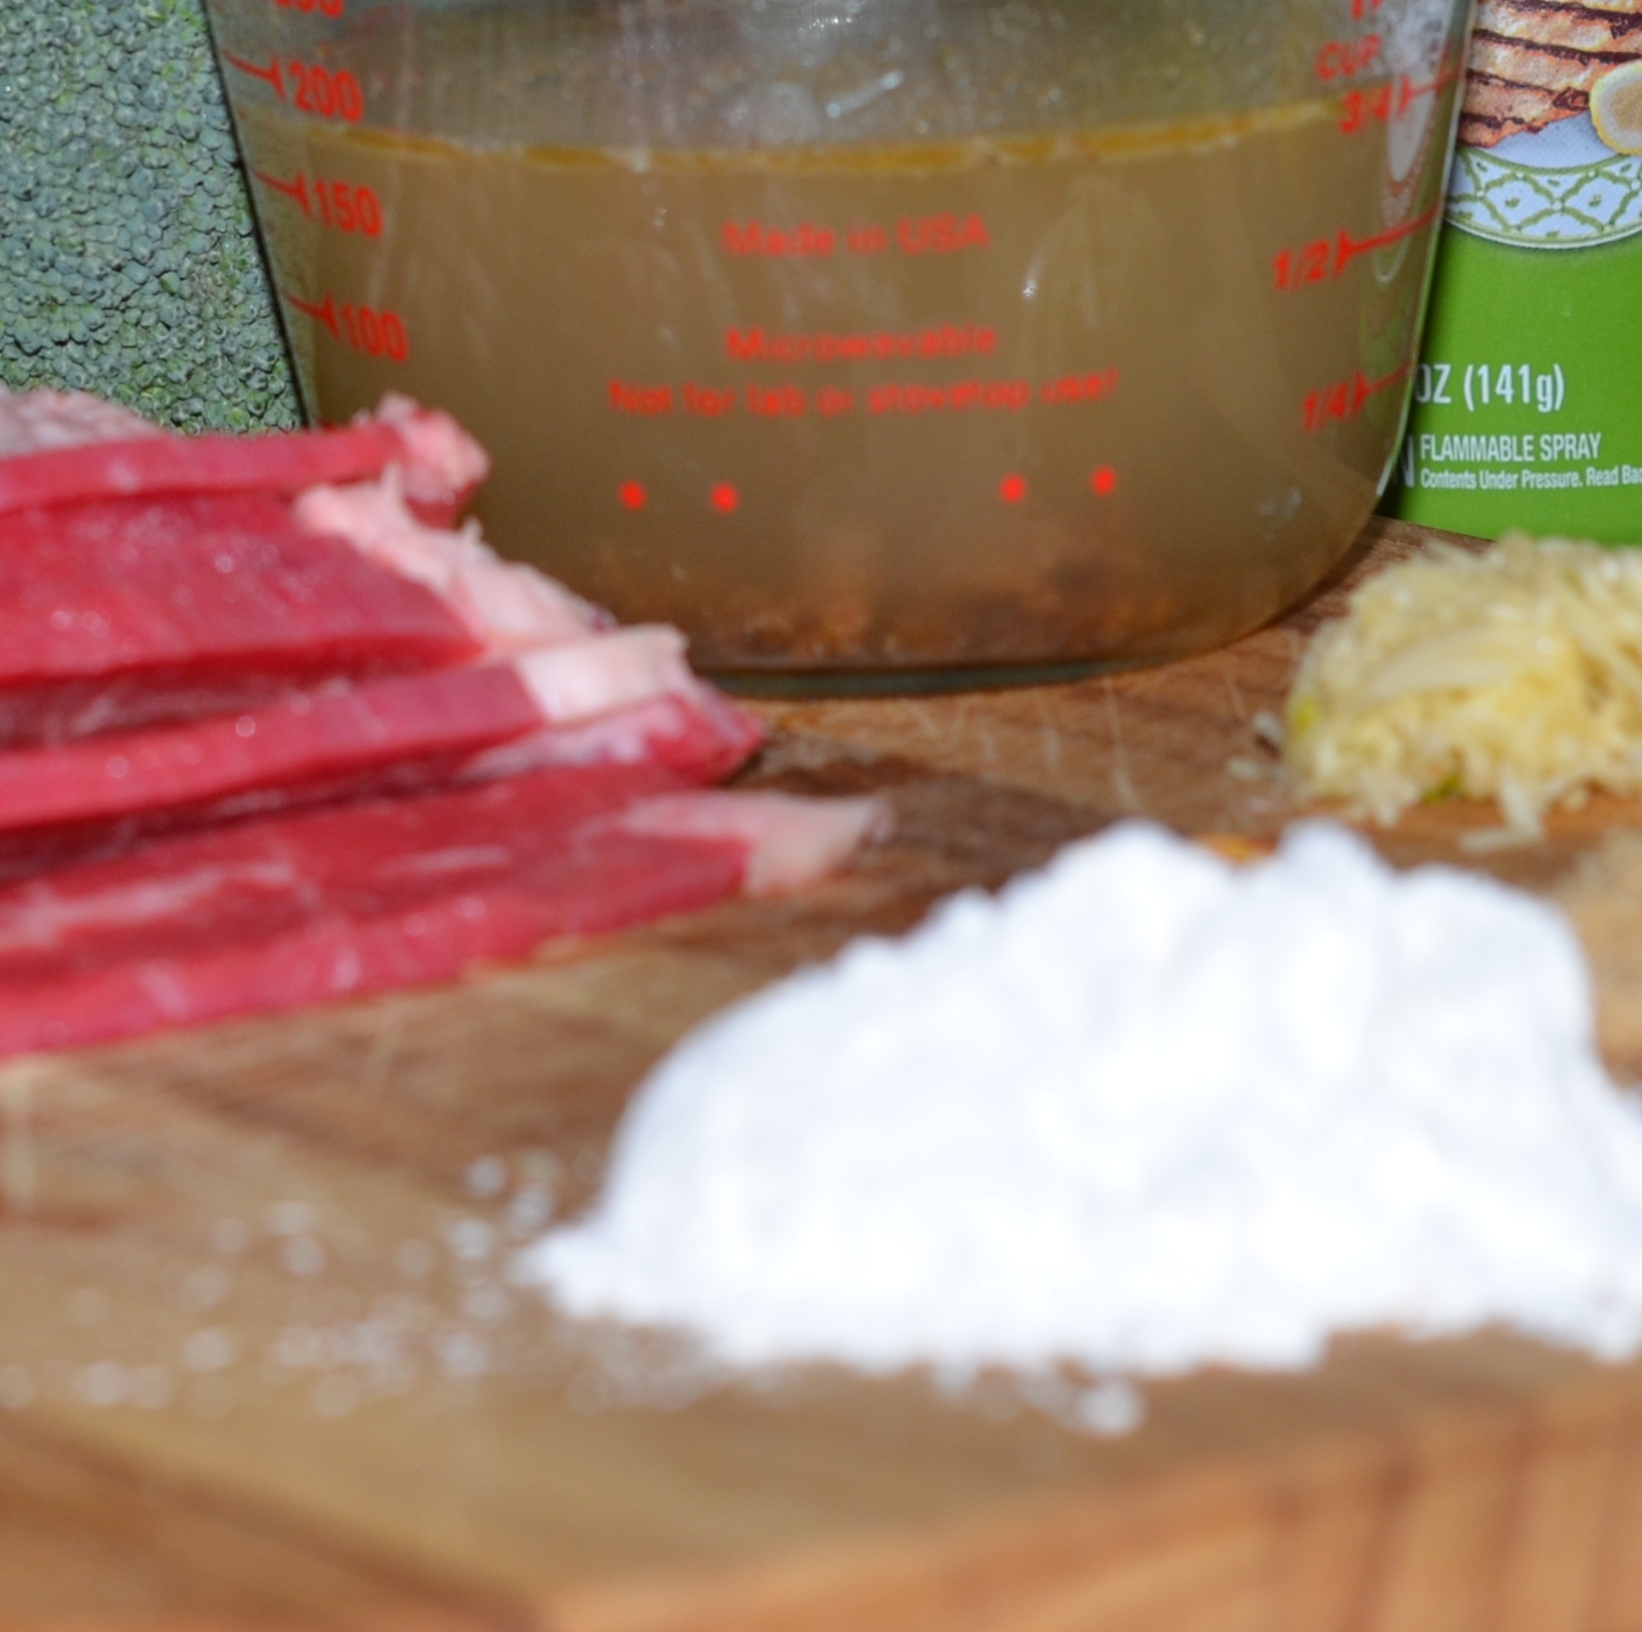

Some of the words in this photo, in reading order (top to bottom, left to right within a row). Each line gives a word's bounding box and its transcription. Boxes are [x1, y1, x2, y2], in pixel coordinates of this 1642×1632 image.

[288, 59, 364, 124] 200
[313, 176, 384, 242] 150
[720, 218, 837, 259] Made
[846, 223, 888, 256] in
[895, 211, 990, 256] USA
[1271, 238, 1329, 295] 1/2
[341, 300, 410, 363] 100
[1463, 362, 1566, 413] (141g)
[1419, 433, 1535, 462] FLAMMABLE
[1539, 432, 1602, 462] SPRAY
[1420, 468, 1477, 490] Contents
[1478, 469, 1517, 490] Under
[1520, 468, 1584, 490] Pressure.
[1585, 466, 1619, 488] Read
